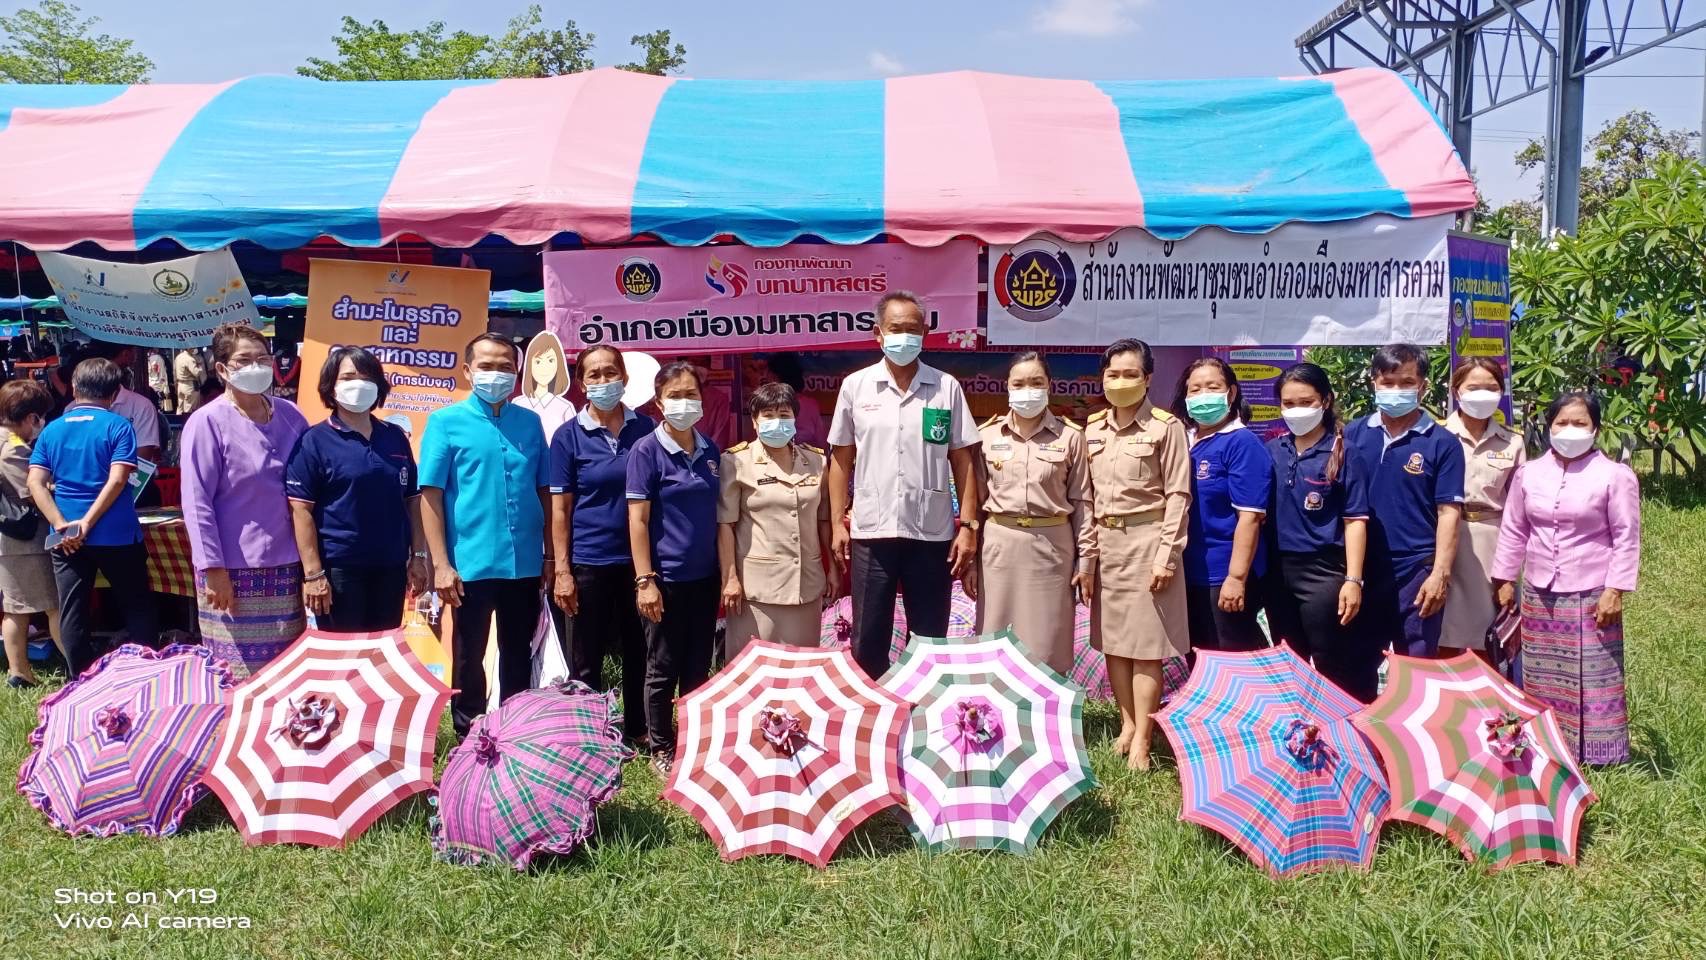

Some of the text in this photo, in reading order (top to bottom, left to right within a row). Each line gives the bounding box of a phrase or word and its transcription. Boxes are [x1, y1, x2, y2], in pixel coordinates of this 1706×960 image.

[754, 258, 852, 272] กองทุนพัฒนา
[756, 273, 887, 295] บทบาทสตรี
[1082, 240, 1445, 319] สำนักงานพัฒนาชุมชนอำเภอเมืองมหาสารคาม
[333, 296, 460, 328] สำมะโนธุรกิจ
[383, 327, 417, 342] และ
[580, 309, 938, 344] อำเภอเมืองมหาสารม
